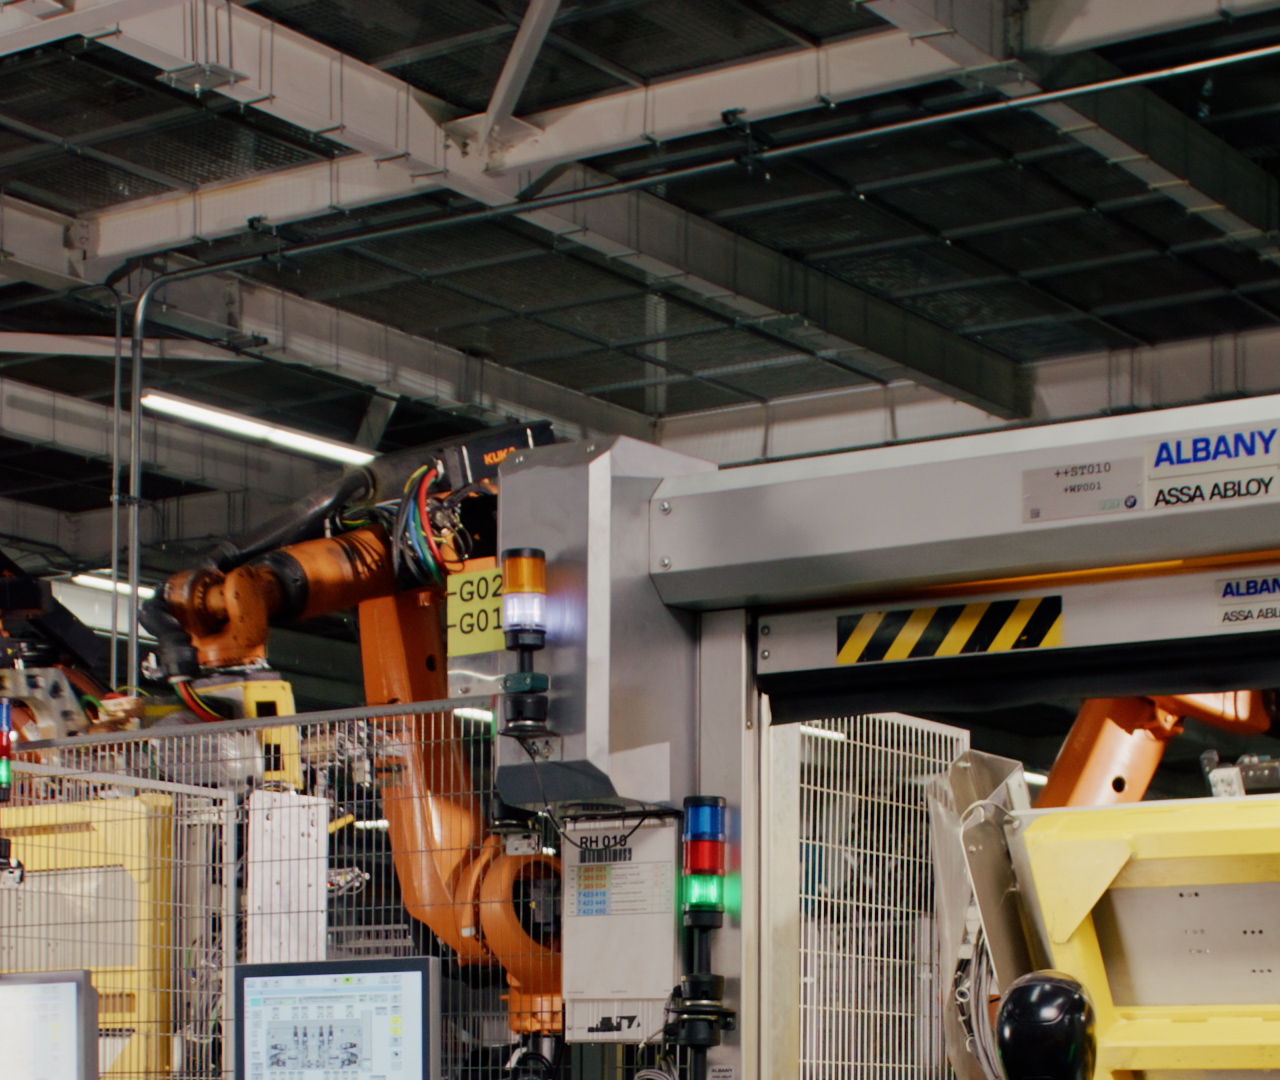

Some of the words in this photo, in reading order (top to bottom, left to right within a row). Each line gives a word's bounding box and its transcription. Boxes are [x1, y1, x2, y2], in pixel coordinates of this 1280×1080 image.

[1153, 428, 1279, 468] ALBANY
[1054, 462, 1112, 478] ++ST010
[1154, 484, 1205, 506] ASSA
[1209, 476, 1274, 501] ABLOY
[1221, 608, 1255, 623] ASSA
[579, 835, 599, 848] RH
